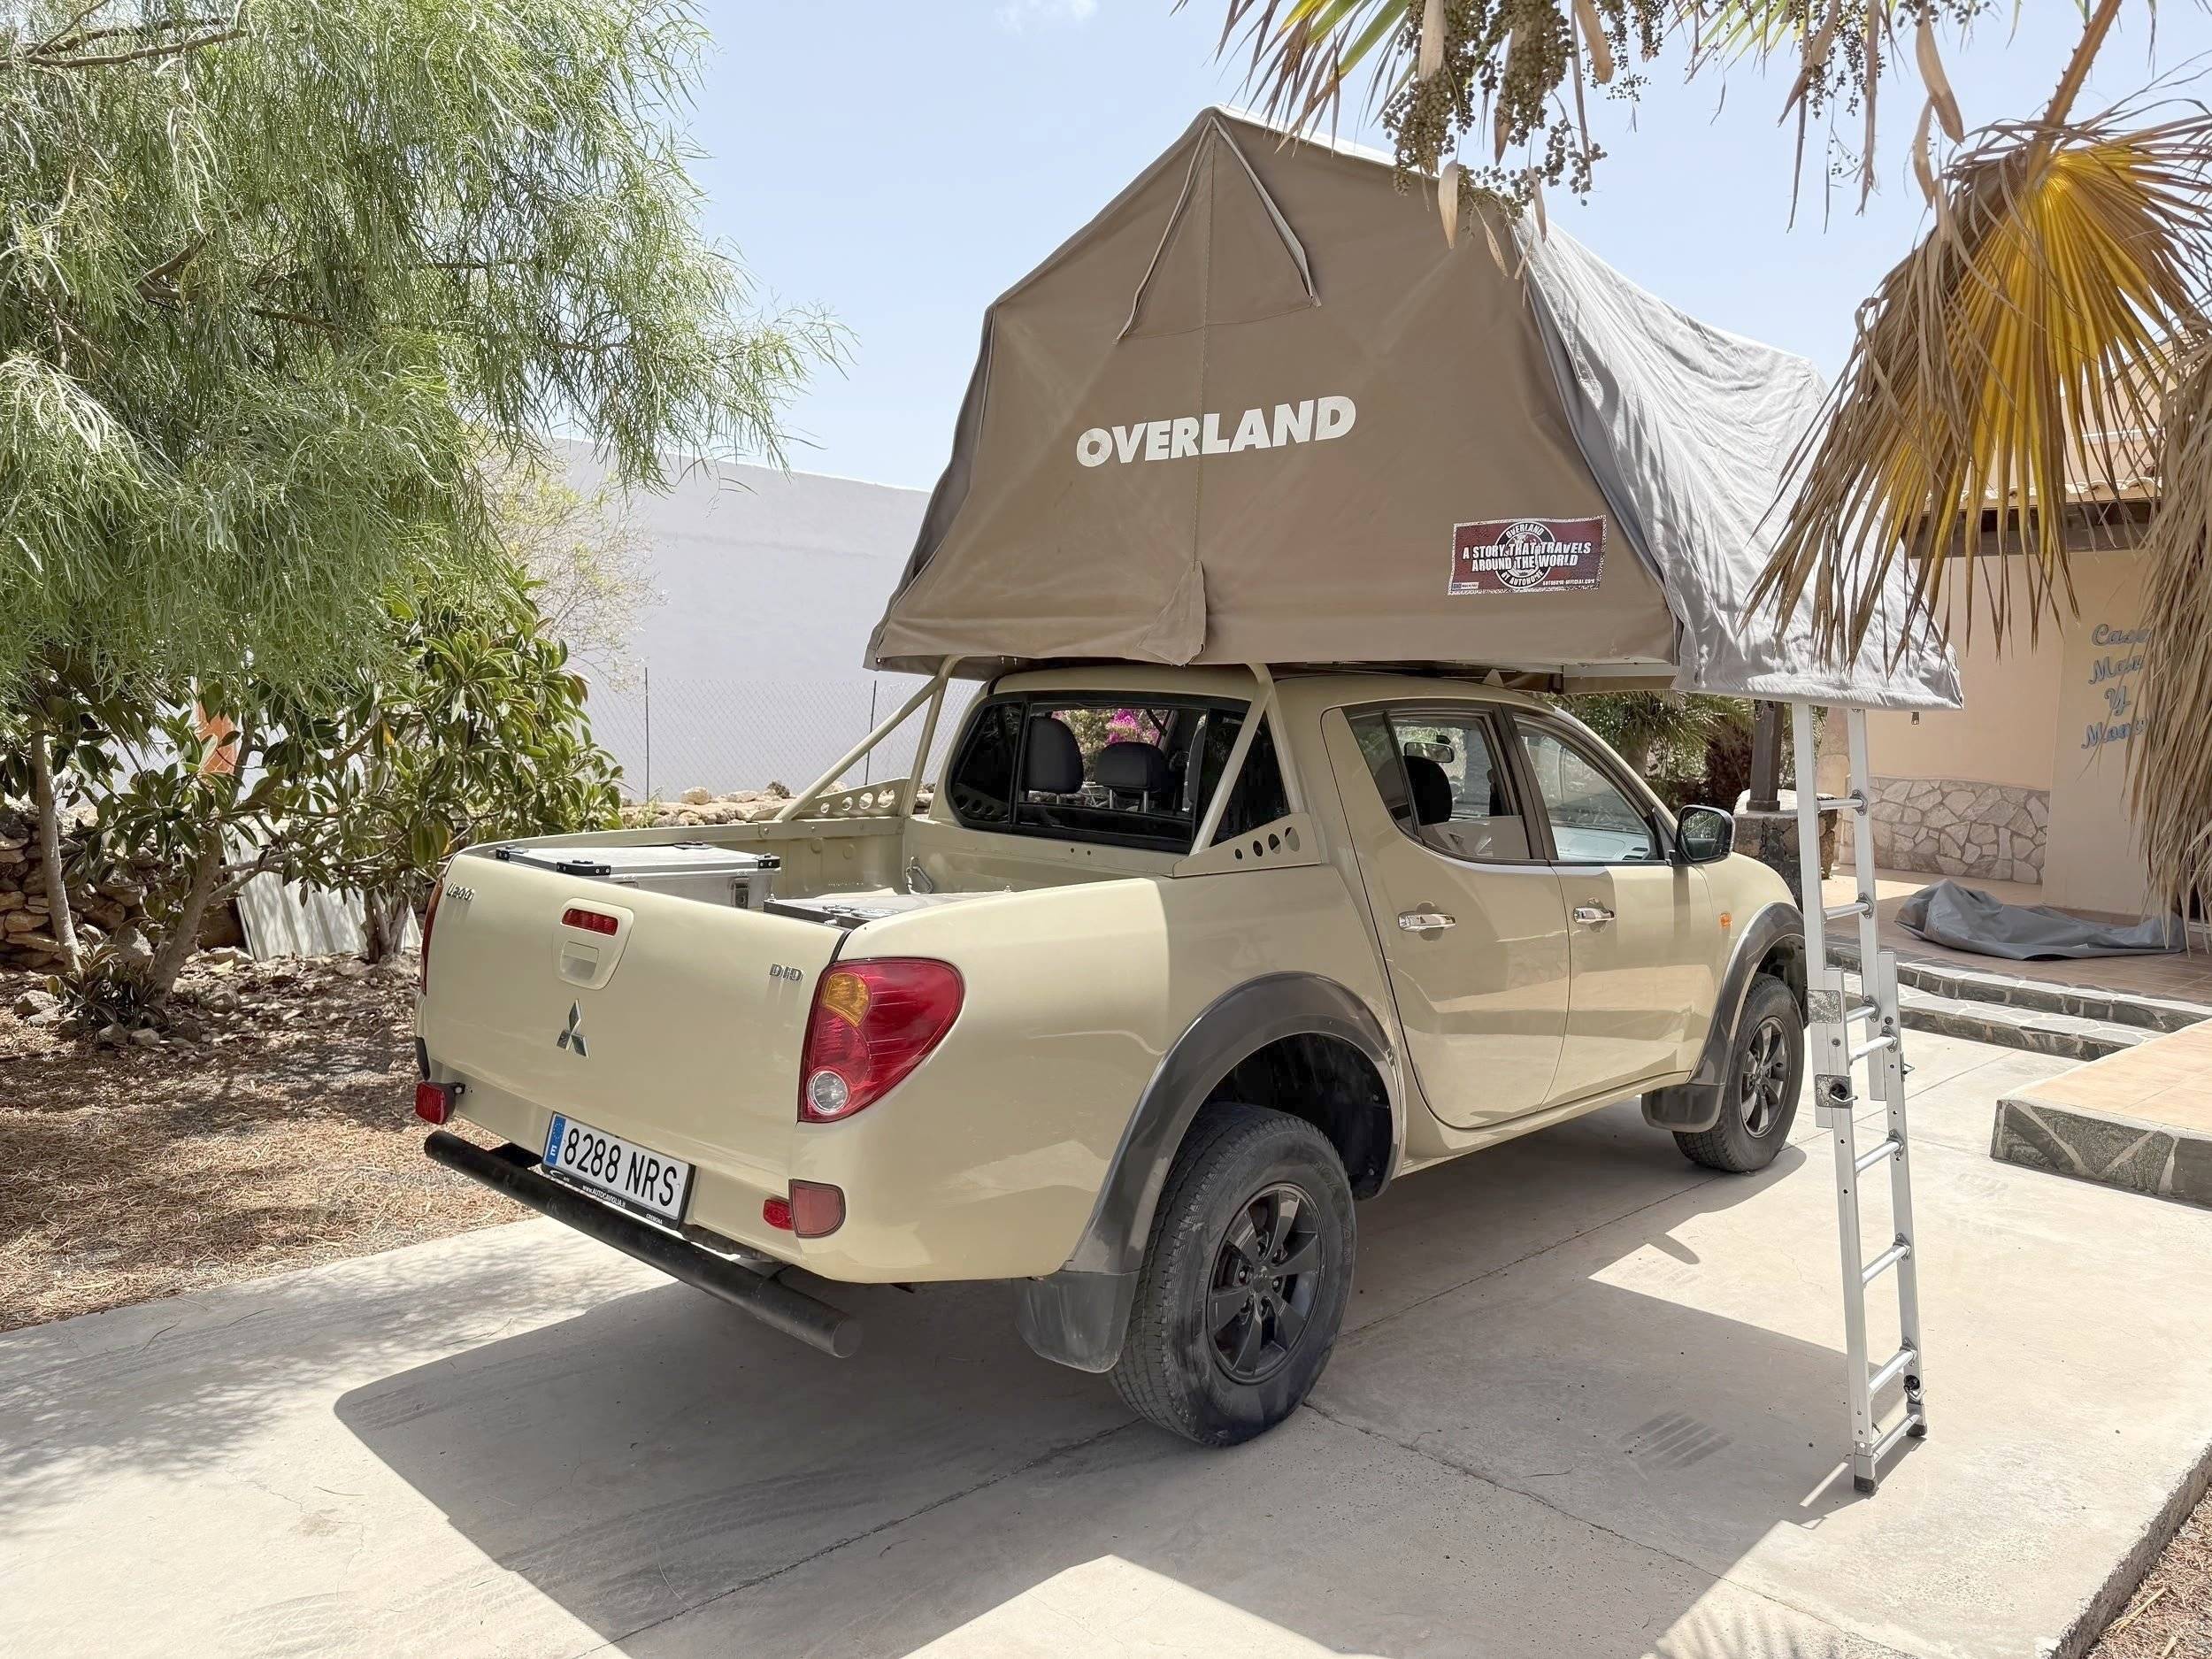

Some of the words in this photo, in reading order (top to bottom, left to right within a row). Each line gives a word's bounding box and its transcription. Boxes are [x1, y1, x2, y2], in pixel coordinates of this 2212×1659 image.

[1076, 396, 1356, 467] OVERLAND
[1505, 523, 1545, 539] OVERLAND
[1463, 547, 1470, 559] A
[1472, 545, 1504, 559] STORY
[1509, 542, 1536, 557] THAT
[1540, 541, 1592, 555] TRAVELS
[1471, 557, 1512, 572] AROUND
[1516, 556, 1535, 570] THE
[1538, 555, 1578, 567] WORLD
[1501, 571, 1510, 581] BY
[549, 1145, 557, 1156] E
[564, 1127, 621, 1184] 8288
[626, 1151, 678, 1207] NRS
